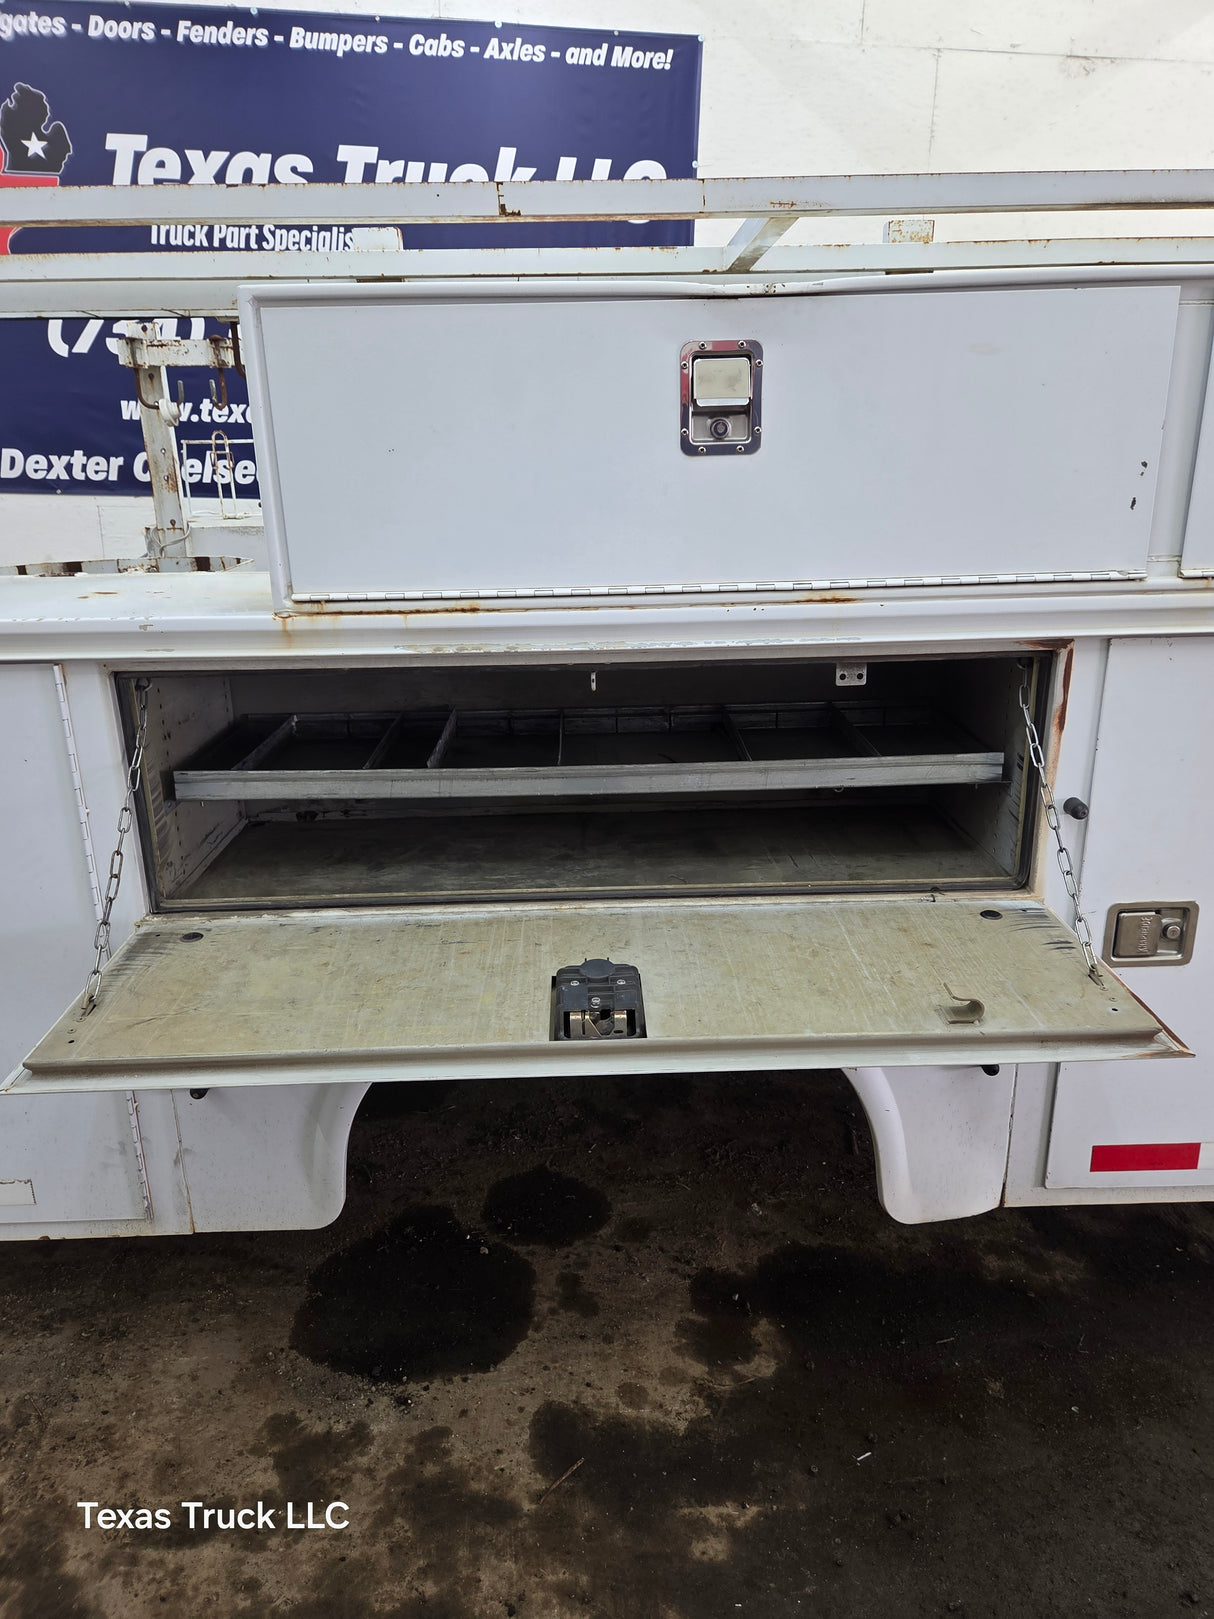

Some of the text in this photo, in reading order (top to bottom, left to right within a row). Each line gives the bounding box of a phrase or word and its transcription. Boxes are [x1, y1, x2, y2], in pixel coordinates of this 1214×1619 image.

[88, 15, 155, 40] Doors
[177, 20, 268, 46] Fenders
[290, 26, 388, 57] Bumpers
[409, 34, 465, 57] Cabs
[484, 38, 546, 62] Axles
[566, 43, 607, 66] and
[611, 46, 673, 70] More!
[105, 133, 313, 184] Texas
[213, 225, 259, 249] Part
[1, 448, 123, 481] Dexter
